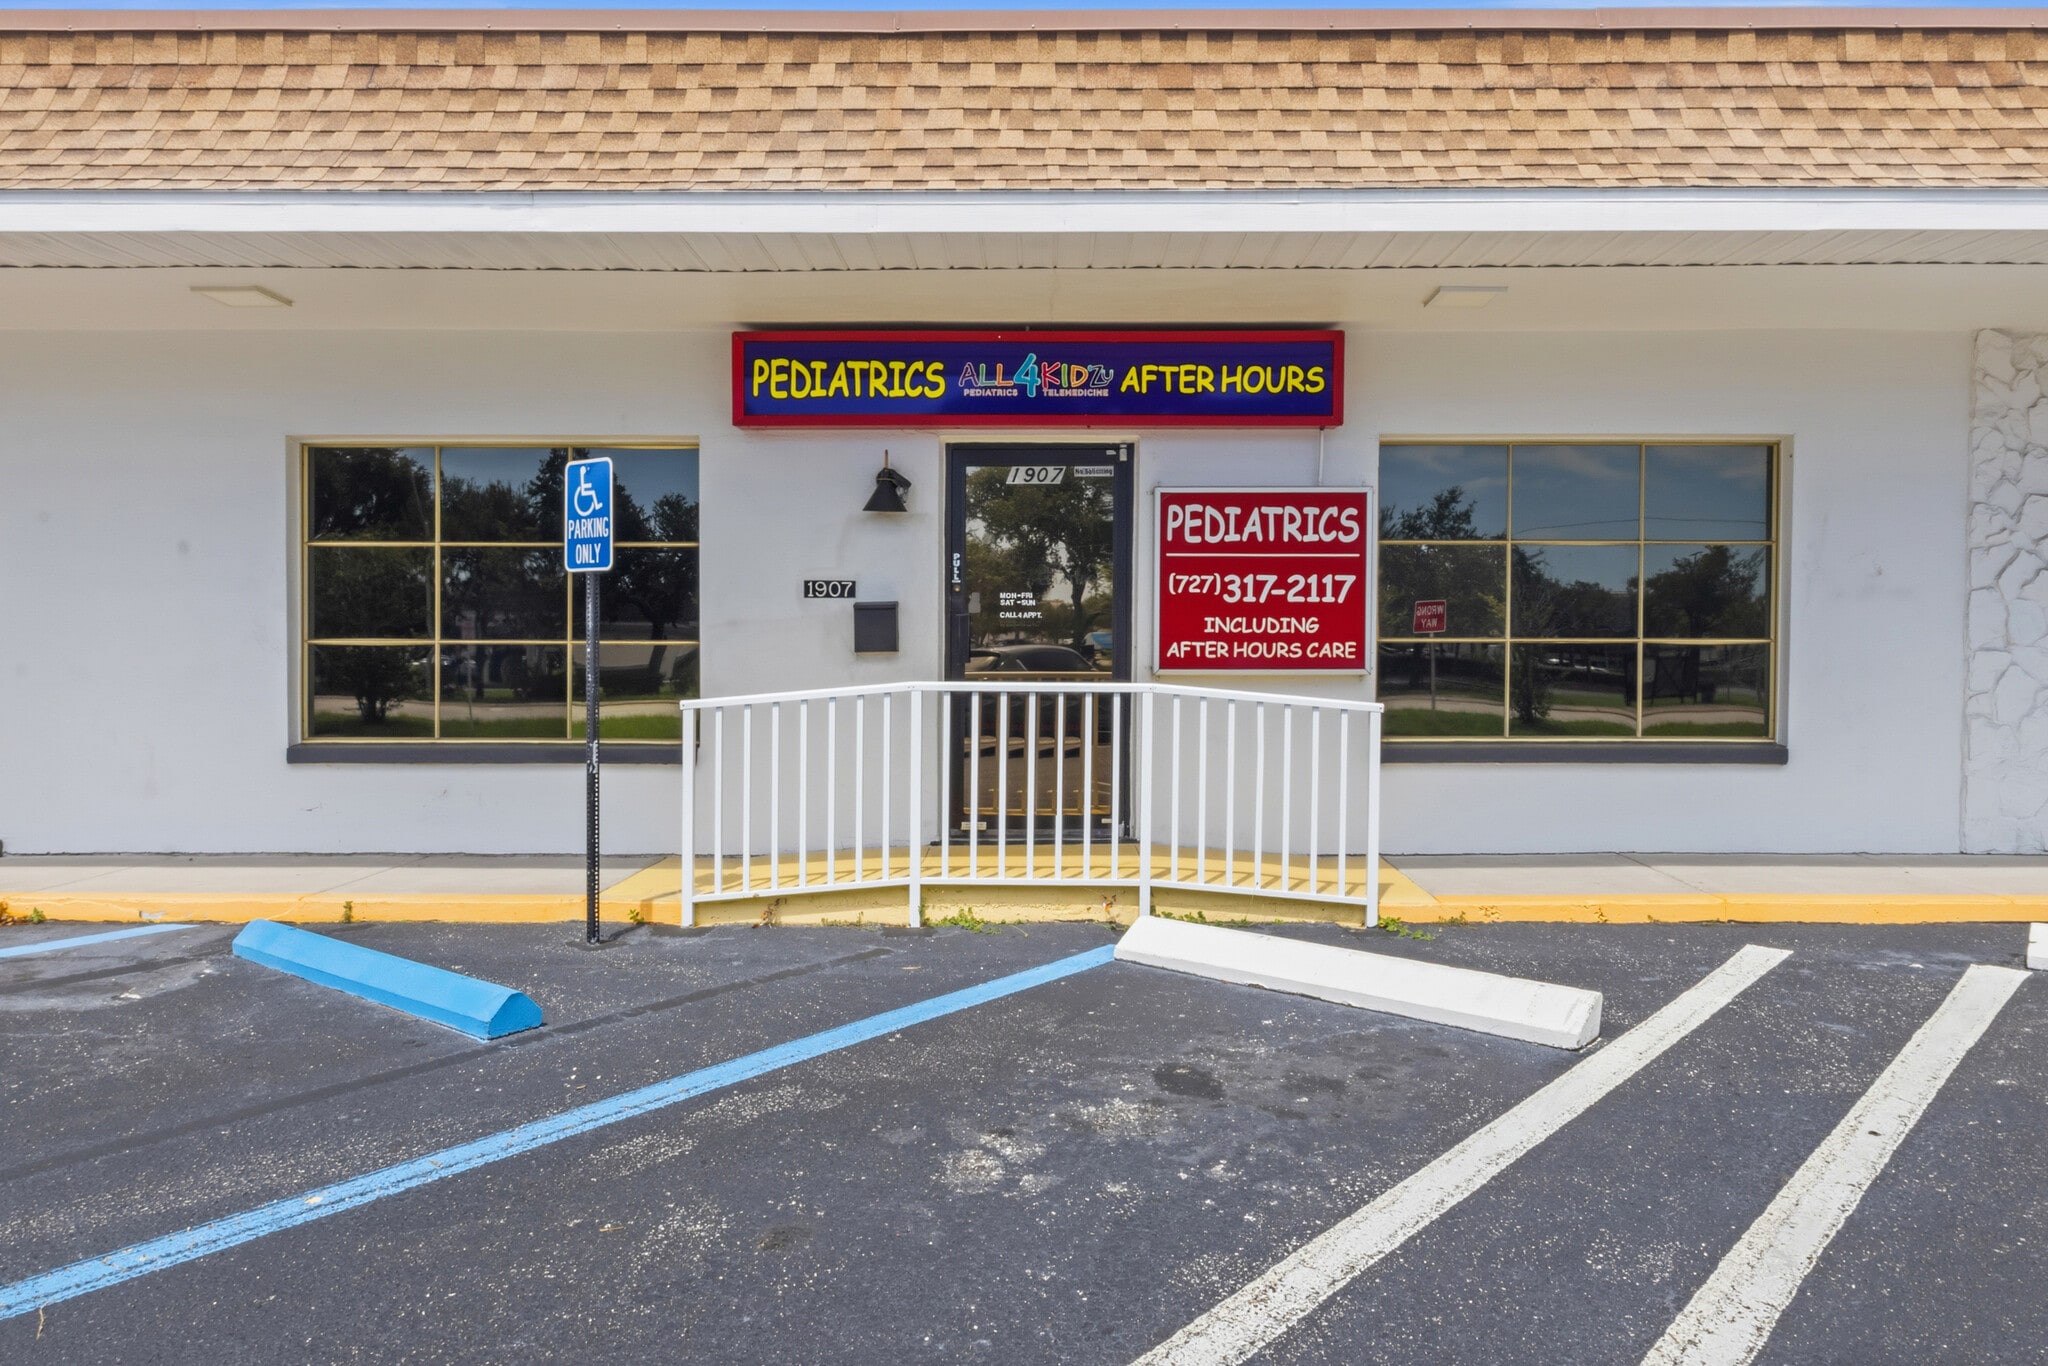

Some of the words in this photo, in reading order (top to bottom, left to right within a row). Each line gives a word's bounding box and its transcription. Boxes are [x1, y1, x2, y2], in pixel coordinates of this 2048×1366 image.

[752, 358, 946, 399] PEDIATRICS
[1120, 364, 1215, 394] AFTER
[1221, 365, 1326, 394] HOURS
[963, 388, 1018, 397] PEDIATRICS
[1043, 388, 1109, 397] TELEMEDICINE
[1012, 467, 1065, 482] 1907
[568, 516, 609, 540] PARKING
[1166, 504, 1360, 544] PEDIATRICS
[575, 543, 601, 564] ONLY
[953, 553, 961, 580] PULL
[807, 581, 853, 597] 1907
[1222, 573, 1357, 604] 317-2117
[1204, 616, 1319, 634] INCLUDING
[1166, 640, 1229, 659] AFTER
[1233, 641, 1302, 659] HOURS
[1306, 641, 1357, 659] CARE
